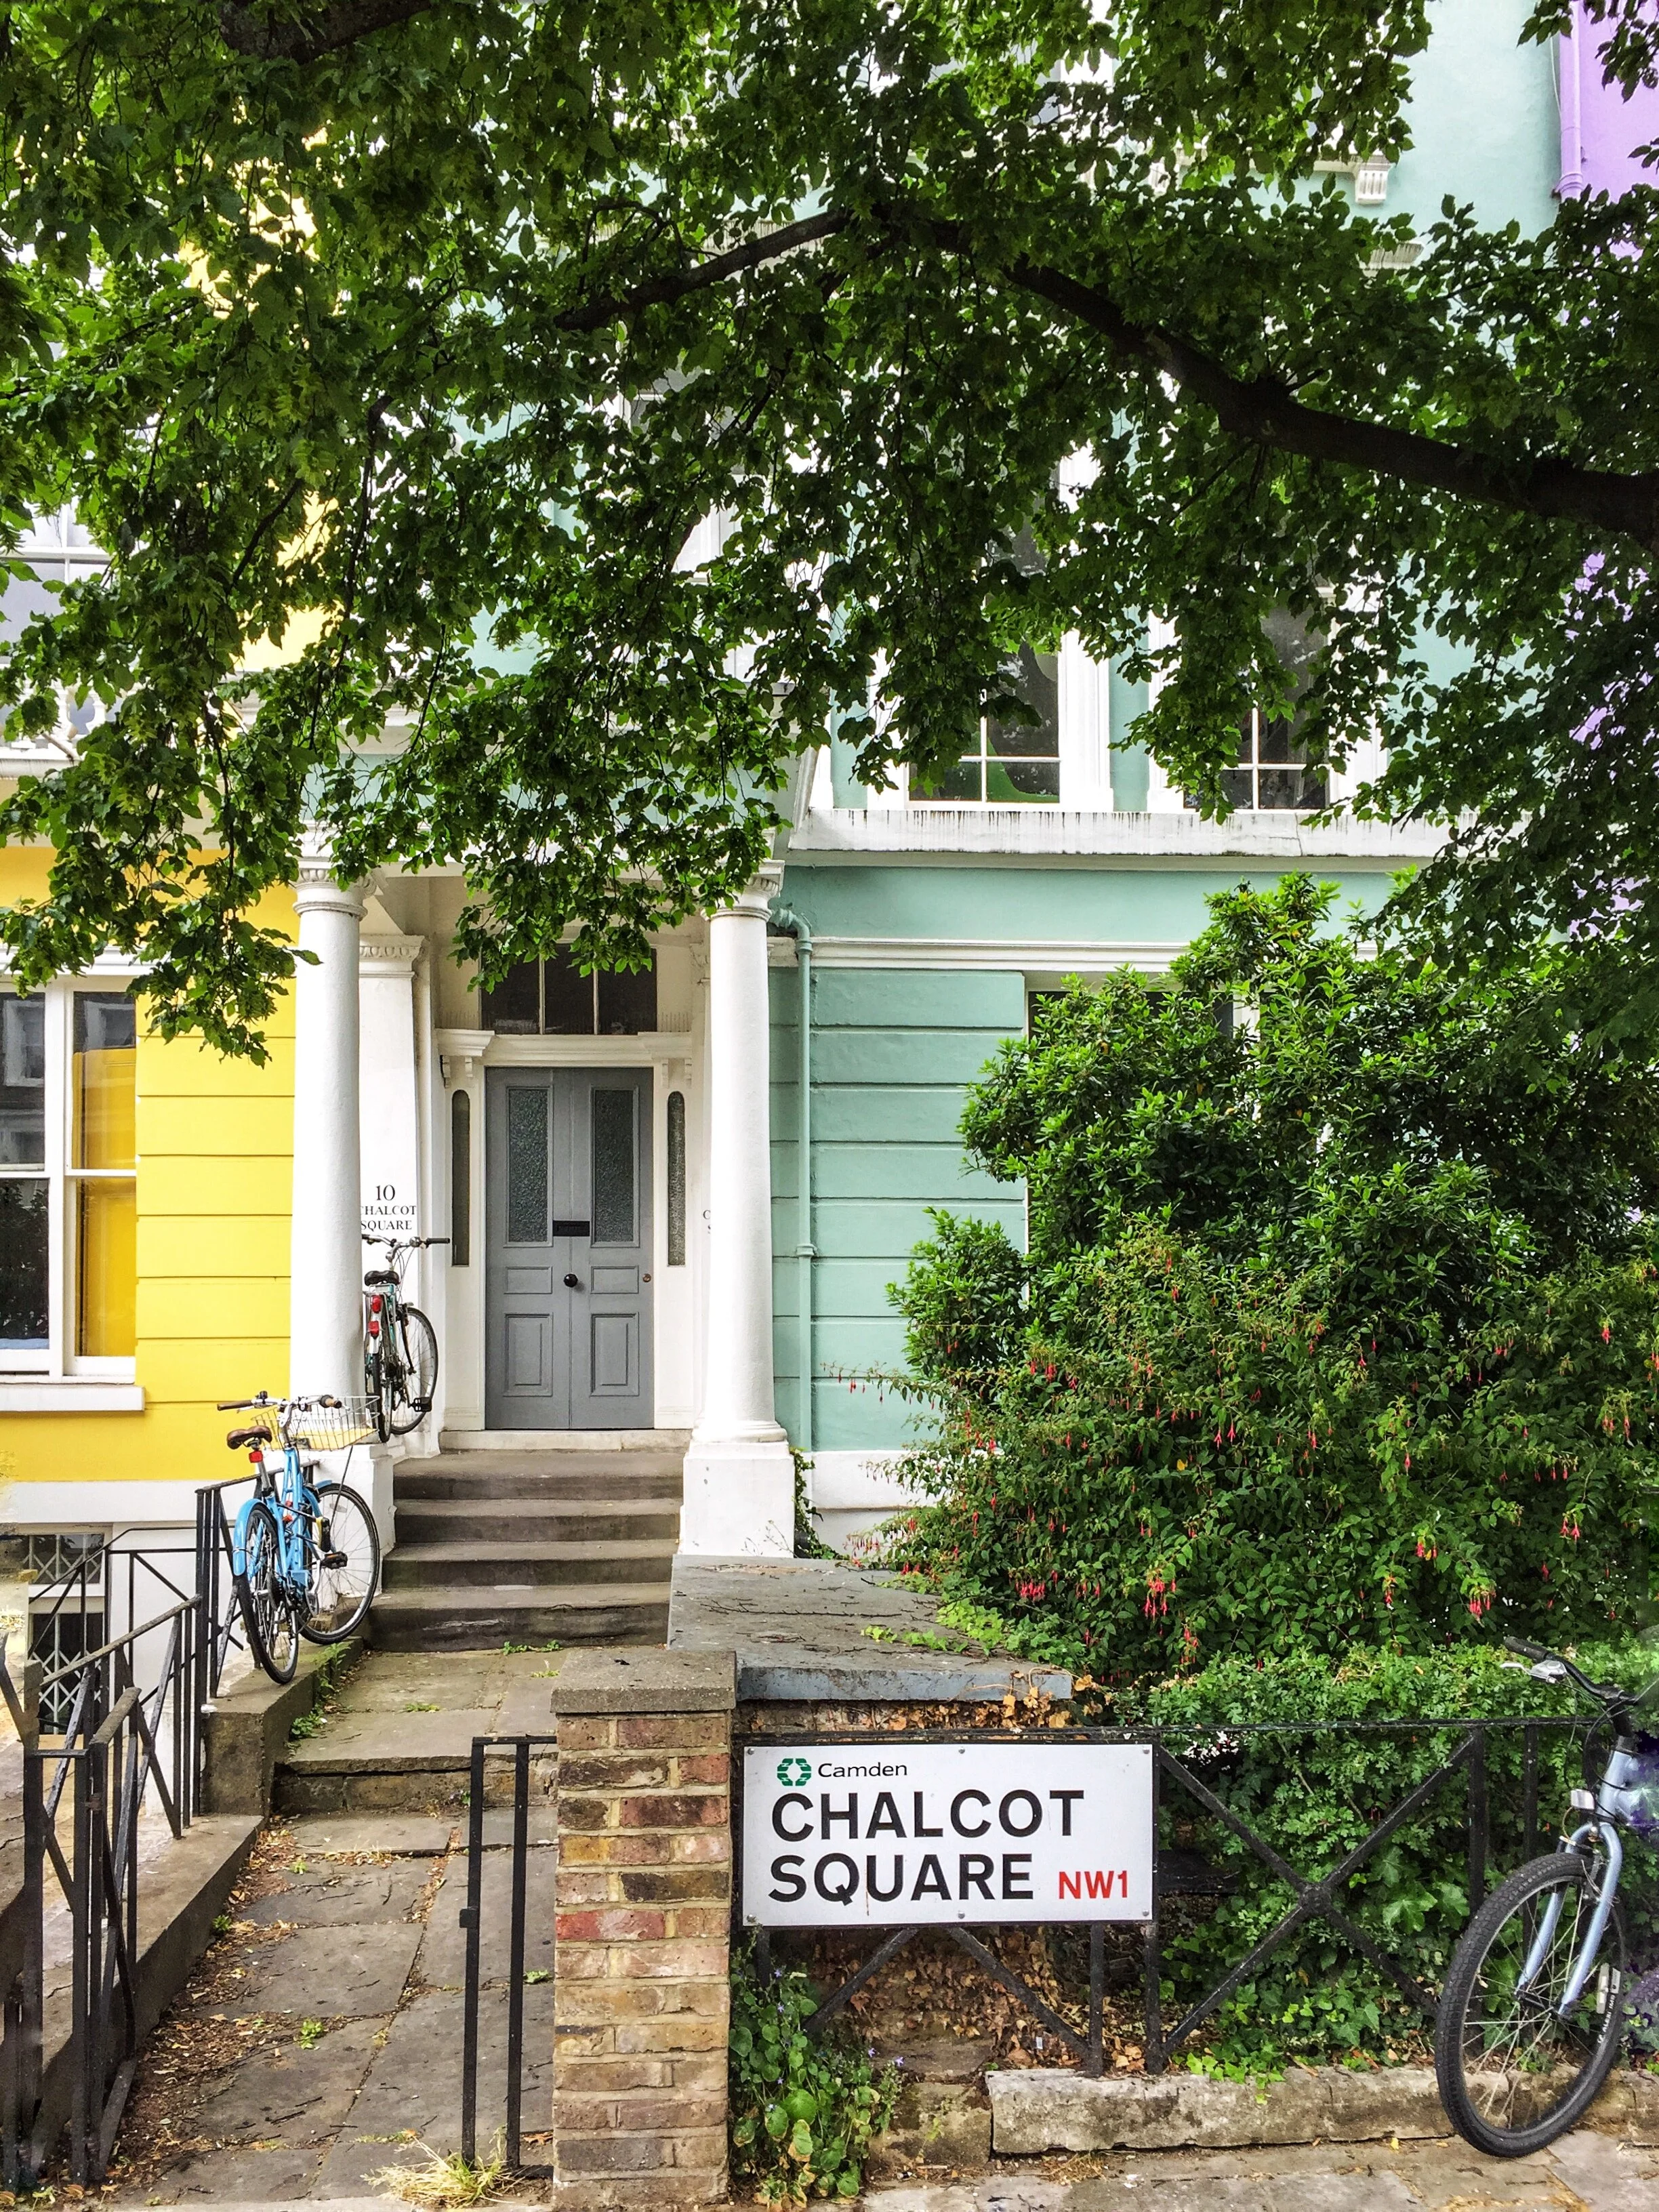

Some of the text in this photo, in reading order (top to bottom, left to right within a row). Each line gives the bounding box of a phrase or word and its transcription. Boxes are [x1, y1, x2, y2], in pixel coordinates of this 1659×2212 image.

[375, 1185, 396, 1201] 10
[361, 1220, 413, 1232] SQUARE
[818, 1761, 907, 1778] Camden
[772, 1789, 1085, 1842] CHALCOT
[768, 1853, 1128, 1906] SQUARE NW1
